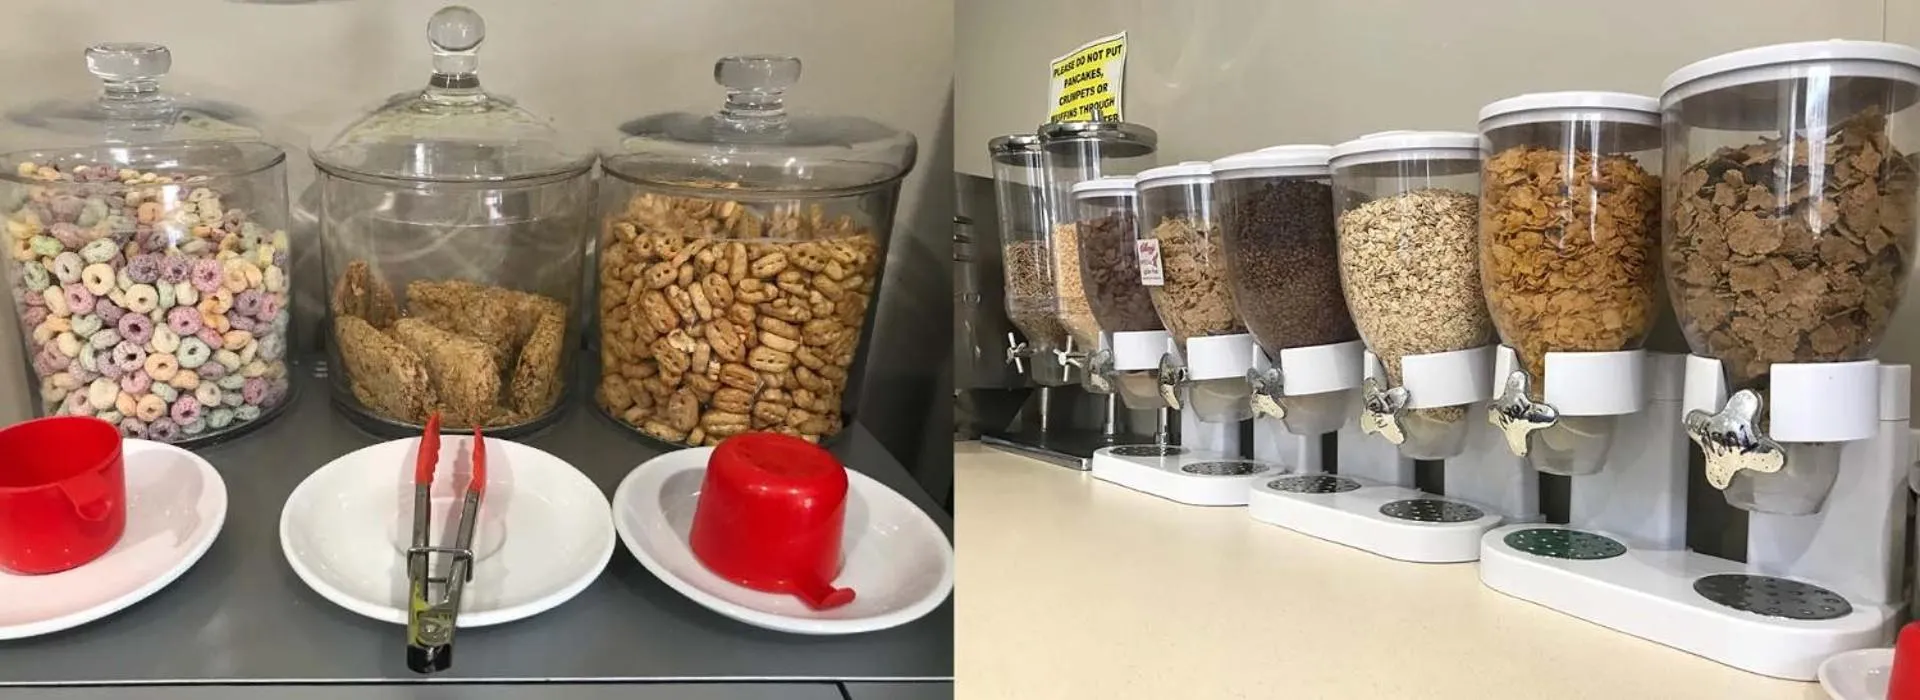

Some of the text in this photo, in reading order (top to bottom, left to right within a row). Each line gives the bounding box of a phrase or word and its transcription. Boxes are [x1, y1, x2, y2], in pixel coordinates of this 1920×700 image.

[1053, 44, 1122, 76] PLEASE DO NOT PUT
[1064, 68, 1103, 88] PANCAKES,
[1059, 83, 1108, 106] CRUMPETS OR
